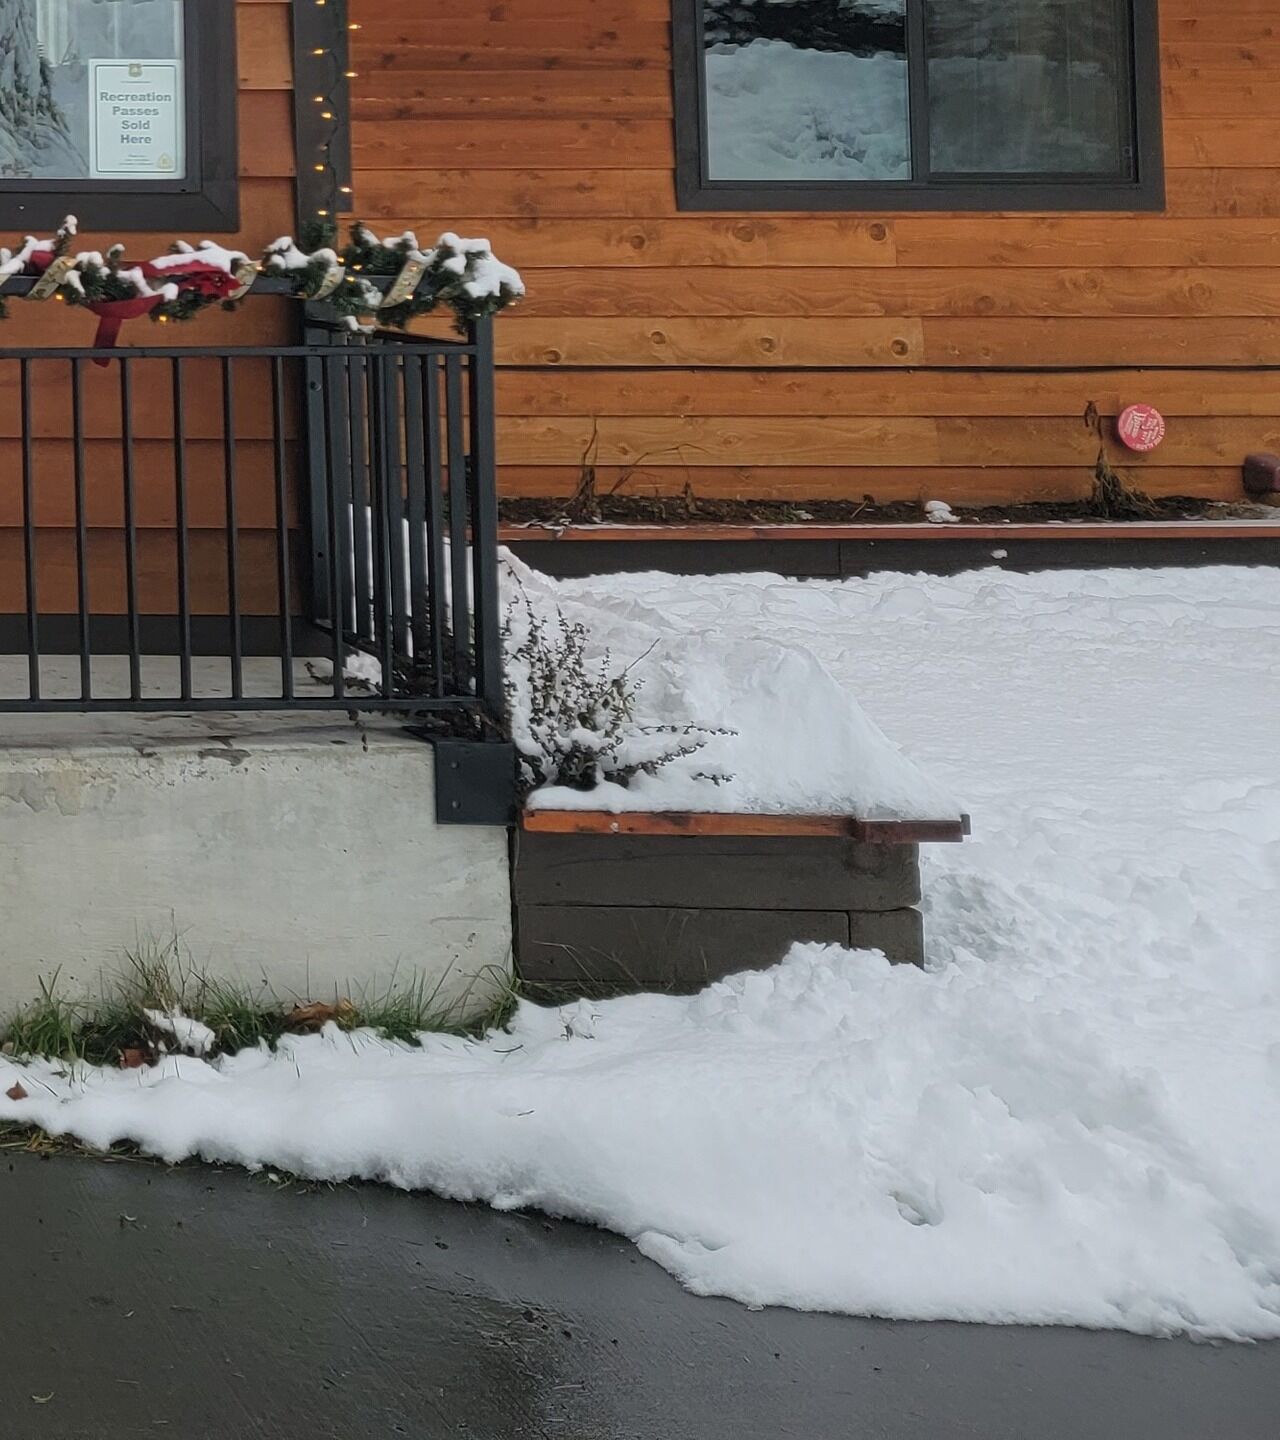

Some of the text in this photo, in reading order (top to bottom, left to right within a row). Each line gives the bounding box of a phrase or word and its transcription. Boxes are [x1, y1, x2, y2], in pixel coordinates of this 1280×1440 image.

[100, 92, 172, 102] Recreation
[112, 106, 160, 116] Passes
[121, 120, 151, 130] Sold
[120, 134, 152, 144] Here
